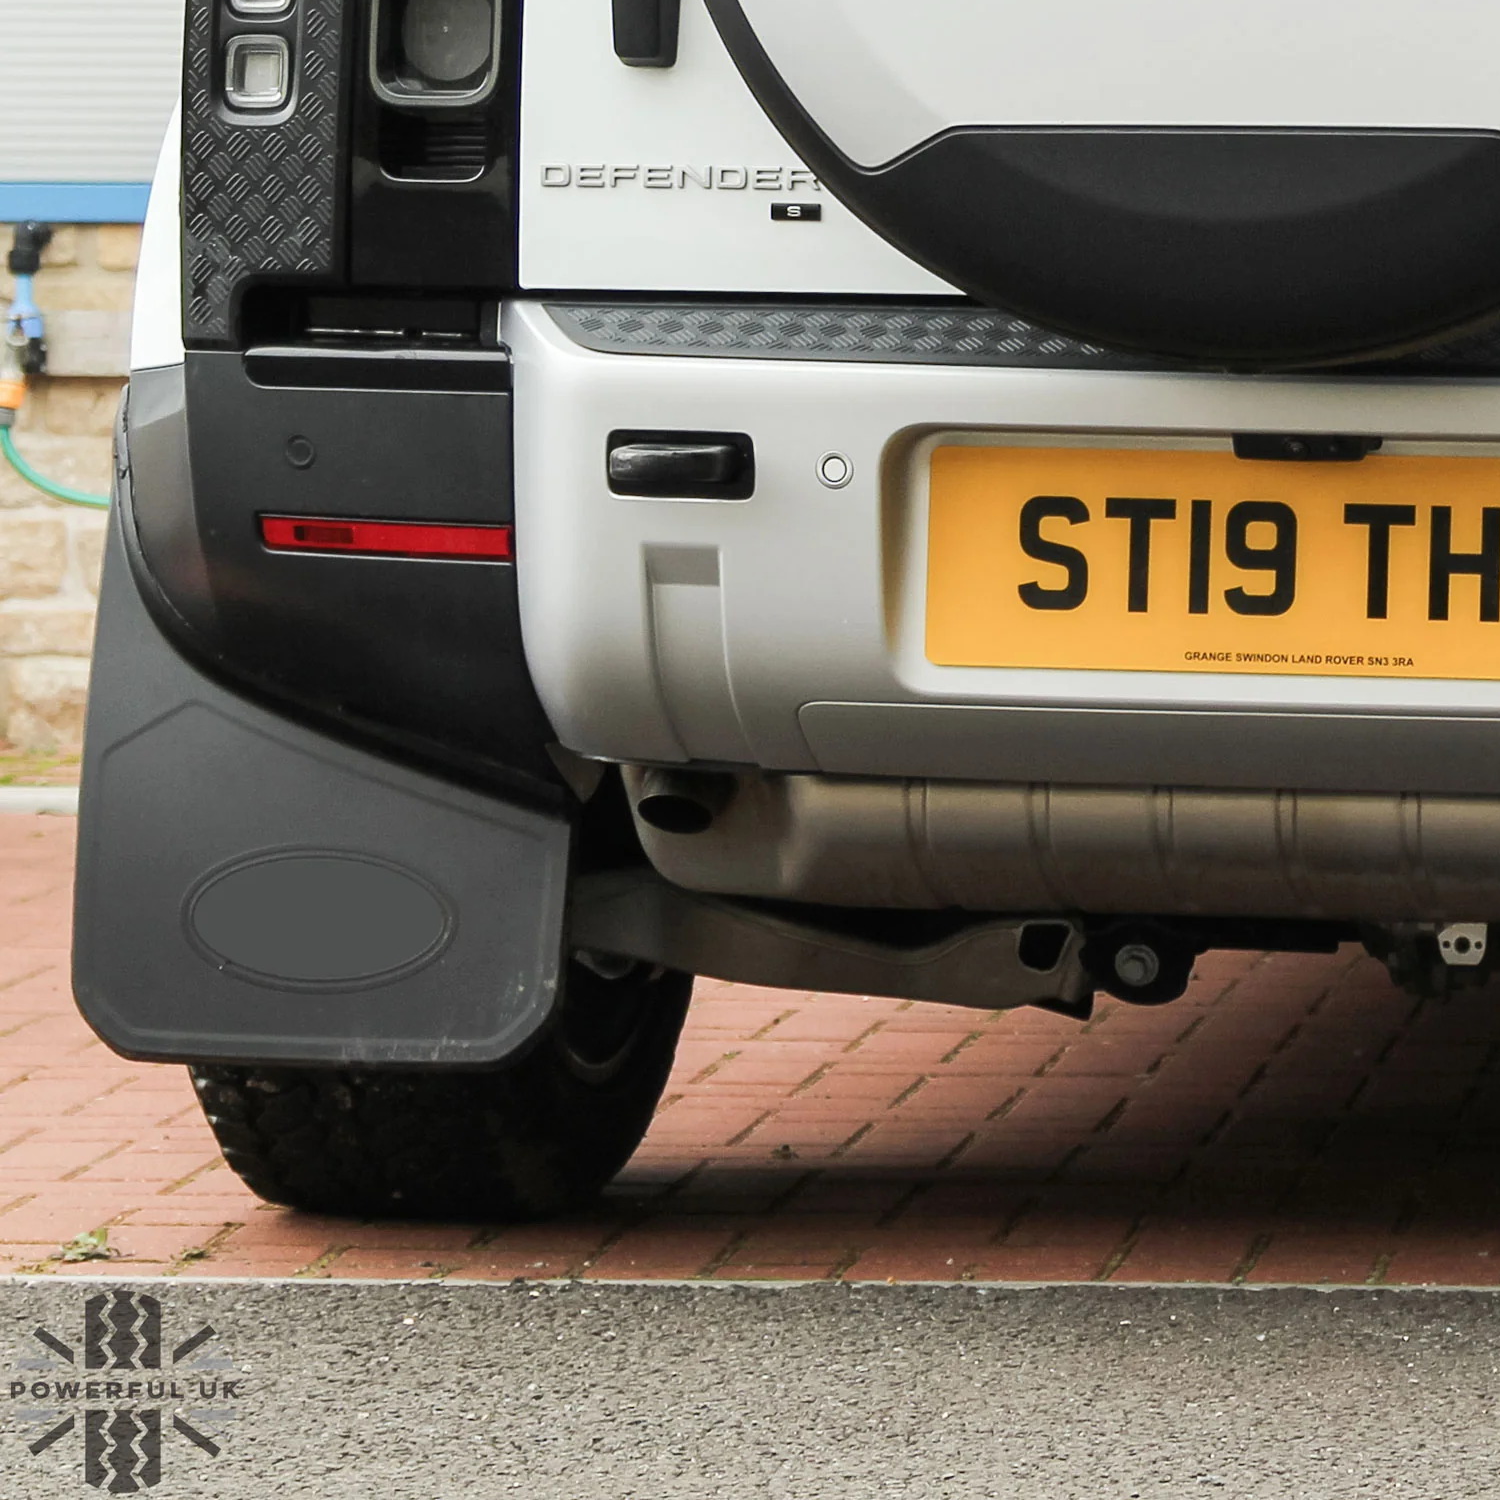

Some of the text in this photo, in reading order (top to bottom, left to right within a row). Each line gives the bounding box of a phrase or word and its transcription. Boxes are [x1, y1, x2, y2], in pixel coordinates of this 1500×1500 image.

[786, 205, 802, 218] S
[1184, 651, 1414, 667] GRANGE SWINDON LAND ROVER SN3 3RA
